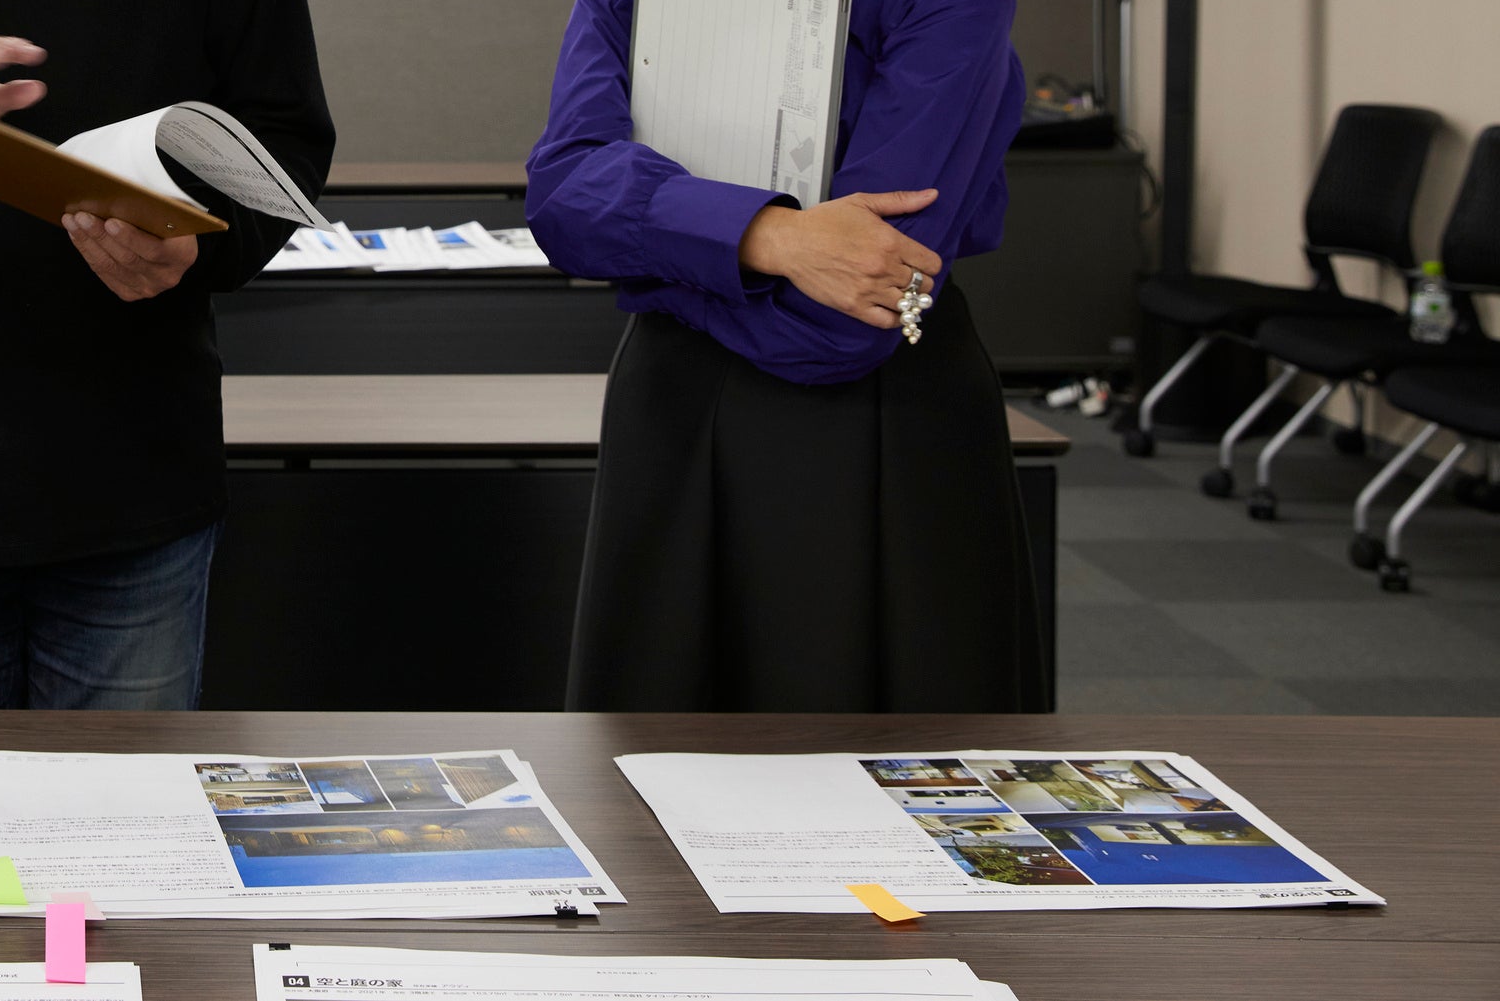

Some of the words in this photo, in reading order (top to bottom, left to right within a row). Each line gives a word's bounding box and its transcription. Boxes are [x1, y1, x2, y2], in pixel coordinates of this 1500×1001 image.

[316, 977, 403, 987] 空と庭の家
